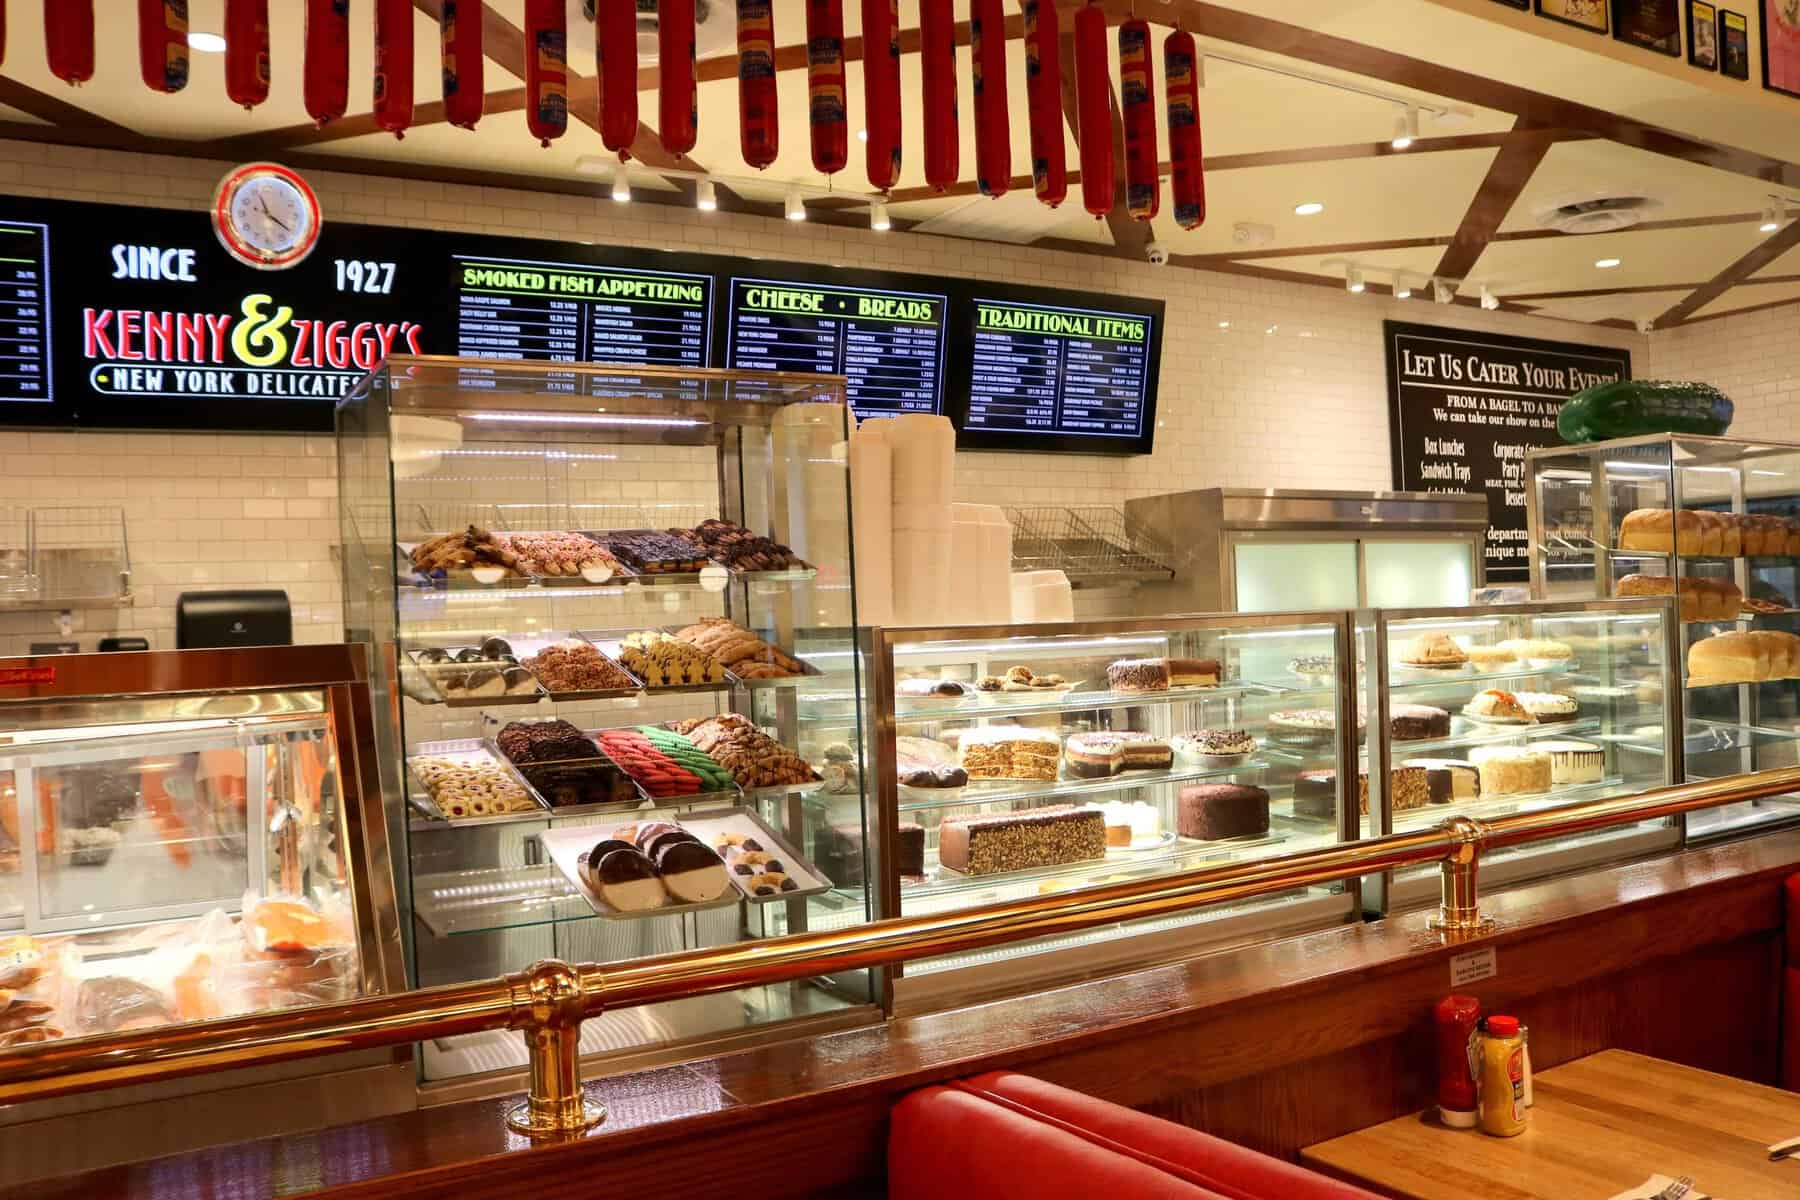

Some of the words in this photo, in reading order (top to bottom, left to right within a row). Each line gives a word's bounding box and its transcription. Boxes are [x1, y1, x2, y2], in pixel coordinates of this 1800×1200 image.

[112, 244, 197, 282] SINCE
[334, 260, 397, 294] 1927
[463, 269, 545, 289] SMOKED
[549, 274, 594, 294] FISH
[597, 280, 703, 301] APPETIZING
[746, 288, 825, 312] CHEESE
[858, 297, 932, 320] BREADS
[83, 307, 232, 363] KENNY
[231, 293, 293, 365] &
[291, 319, 423, 370] ZIGGY'S
[977, 307, 1092, 335] TRADITIONAL
[1096, 320, 1144, 339] ITEMS
[113, 367, 163, 392] NEW
[175, 369, 232, 393] YORK
[1402, 349, 1435, 377] LET
[1439, 353, 1462, 381] US
[1467, 356, 1520, 385] CATER
[1521, 361, 1566, 389] YOUR
[1446, 394, 1477, 409] FROM
[1479, 396, 1487, 409] A
[1489, 397, 1521, 413] BAGEL
[1521, 400, 1535, 414] TO
[1536, 401, 1544, 414] A
[1433, 408, 1448, 421] We
[1450, 412, 1466, 424] can
[1468, 410, 1487, 424] take
[1489, 414, 1504, 425] our
[1506, 412, 1528, 427] show
[1529, 417, 1540, 428] on
[1541, 414, 1555, 429] the
[1424, 437, 1438, 455] Box
[1439, 437, 1465, 457] Lunches
[1493, 440, 1524, 460] Corporate
[1421, 461, 1452, 480] Sandwich
[1453, 462, 1470, 484] Trays
[1502, 461, 1520, 480] Party
